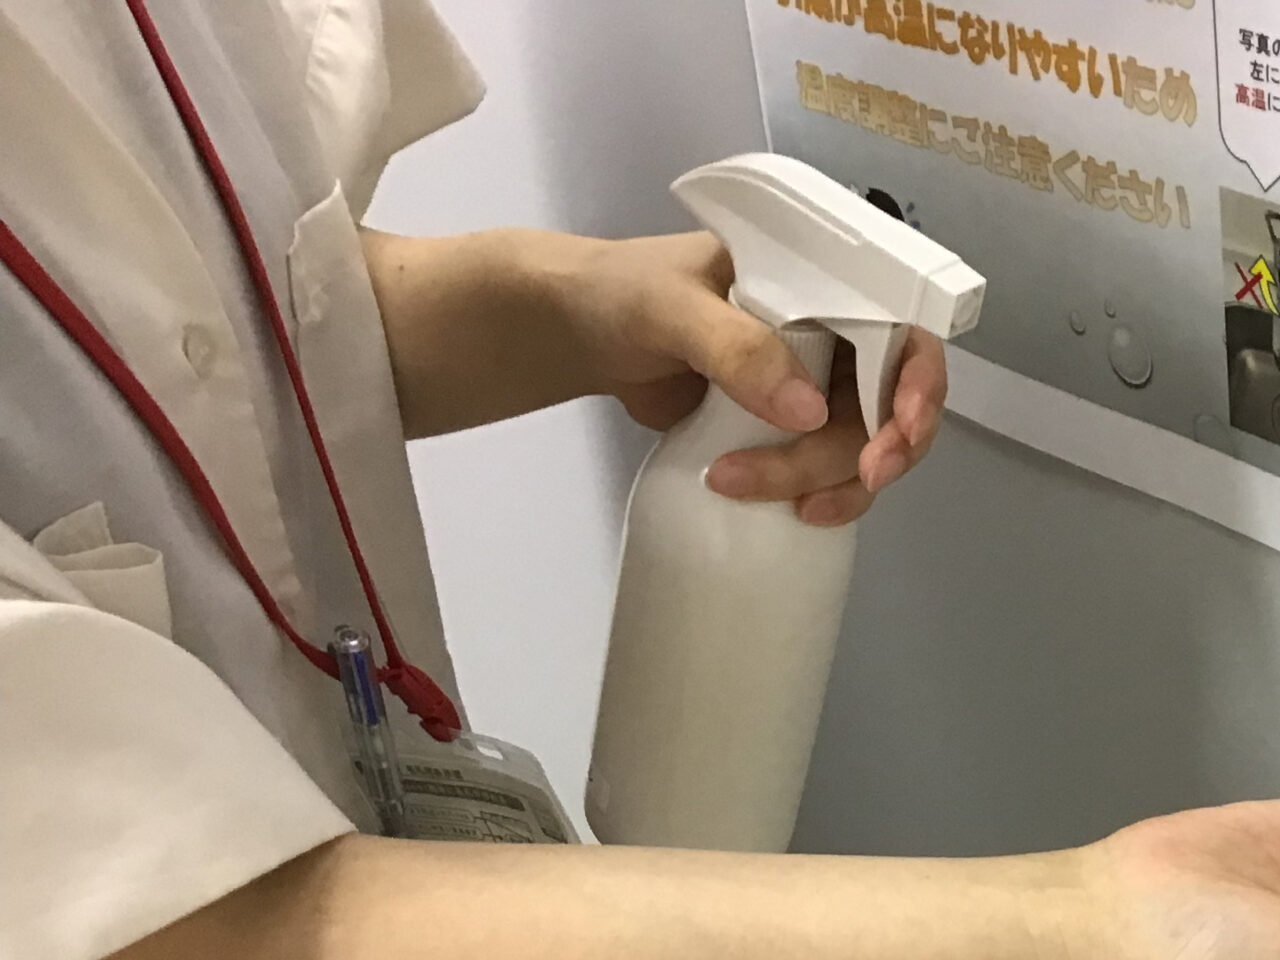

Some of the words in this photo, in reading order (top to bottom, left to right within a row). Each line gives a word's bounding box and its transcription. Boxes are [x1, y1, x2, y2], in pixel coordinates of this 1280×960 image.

[777, 0, 1198, 128] 高温になりやすいため
